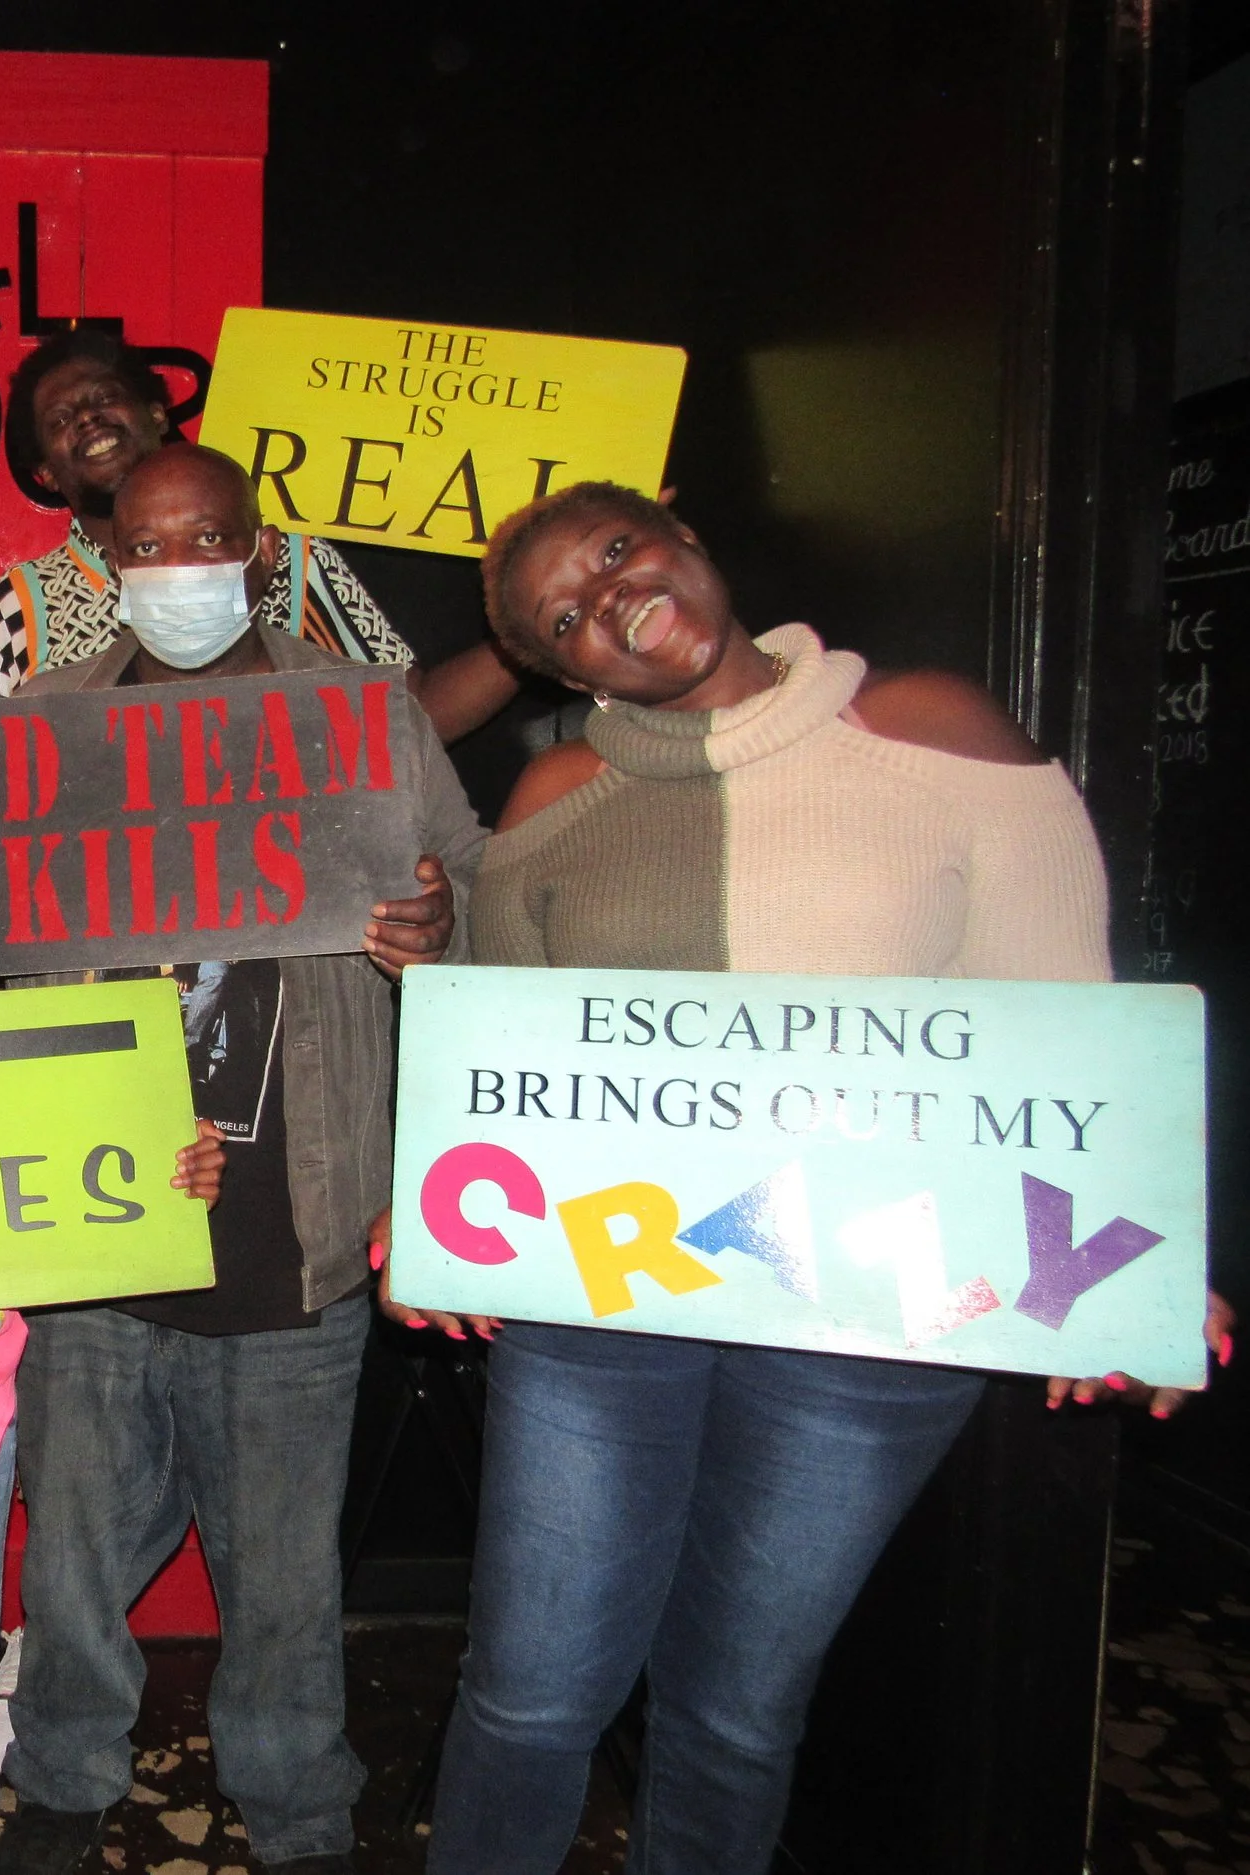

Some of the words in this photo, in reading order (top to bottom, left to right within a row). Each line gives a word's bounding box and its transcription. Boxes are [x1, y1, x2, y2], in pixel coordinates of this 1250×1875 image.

[397, 329, 488, 367] THE
[307, 357, 563, 412] STRUGGLE
[405, 404, 446, 437] IS
[1166, 457, 1217, 492] me
[106, 682, 397, 812] TEAM
[577, 997, 976, 1060] ESCAPING
[214, 1120, 249, 1132] NGELES
[464, 1068, 743, 1131] BRINGS
[768, 1084, 940, 1144] OUT
[968, 1095, 1109, 1152] MY
[420, 1142, 1167, 1350] CRAZY
